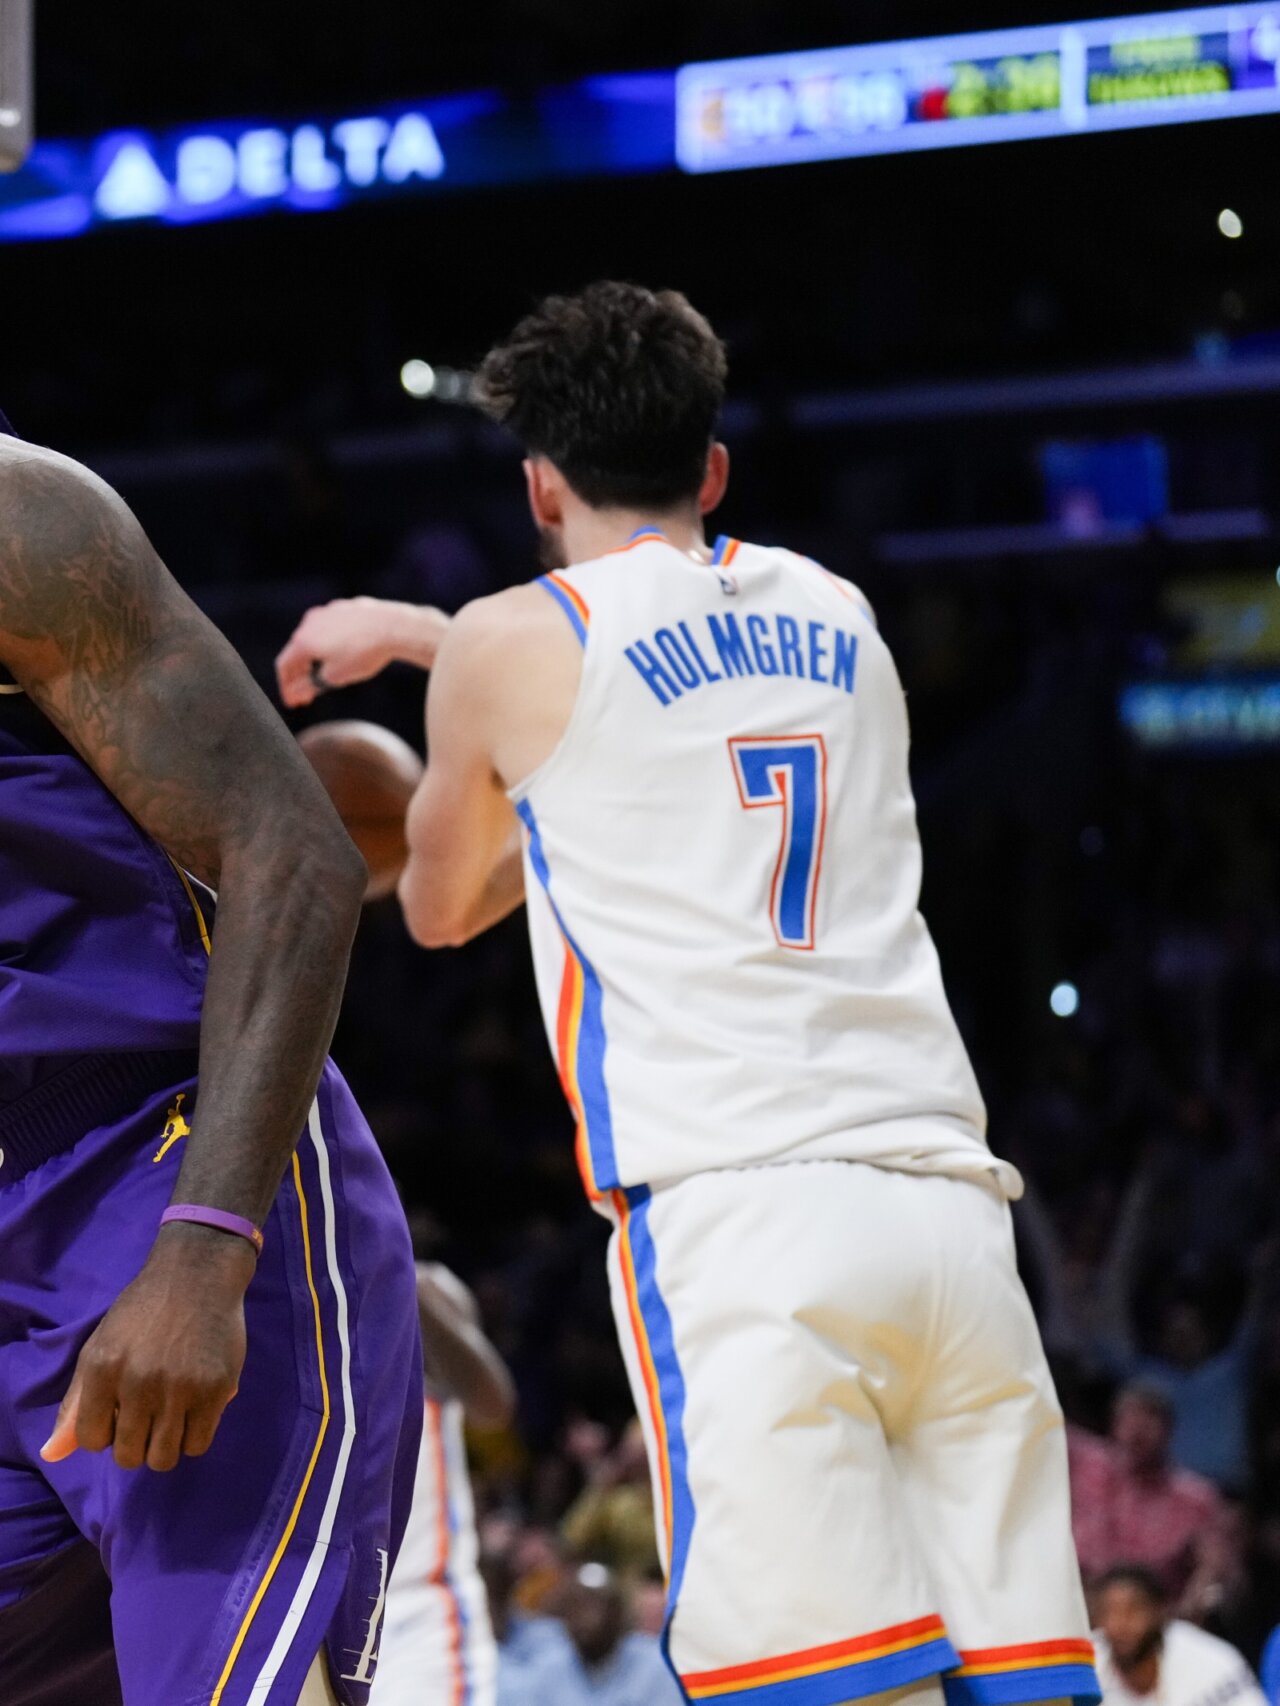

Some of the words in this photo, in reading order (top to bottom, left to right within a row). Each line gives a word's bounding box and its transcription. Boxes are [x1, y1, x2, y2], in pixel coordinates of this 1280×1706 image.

[176, 112, 444, 205] DELTA
[624, 612, 858, 708] HOLMGREN
[727, 733, 828, 951] 7
